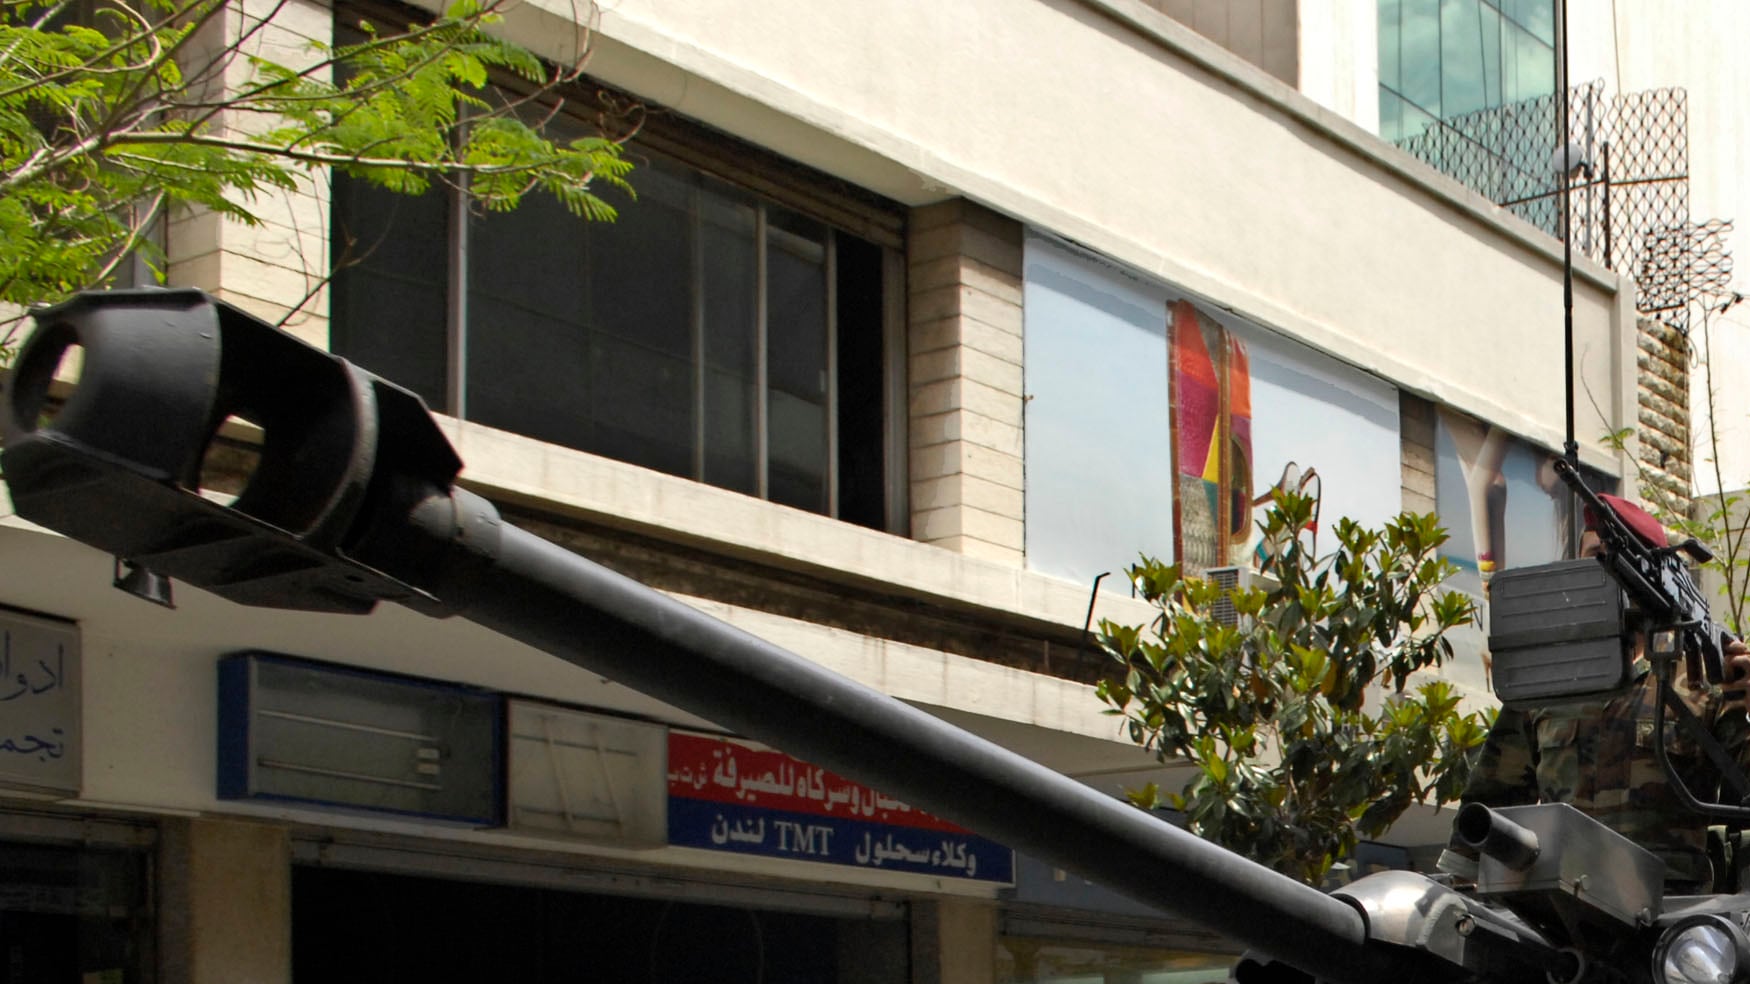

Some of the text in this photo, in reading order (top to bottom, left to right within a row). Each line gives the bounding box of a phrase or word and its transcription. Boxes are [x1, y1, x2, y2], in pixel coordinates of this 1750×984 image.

[0, 628, 64, 701] ادوا
[0, 727, 64, 763] تجم
[713, 746, 794, 802] للصيرفة
[711, 814, 977, 877] وكلاء سحلول TMT لندن
